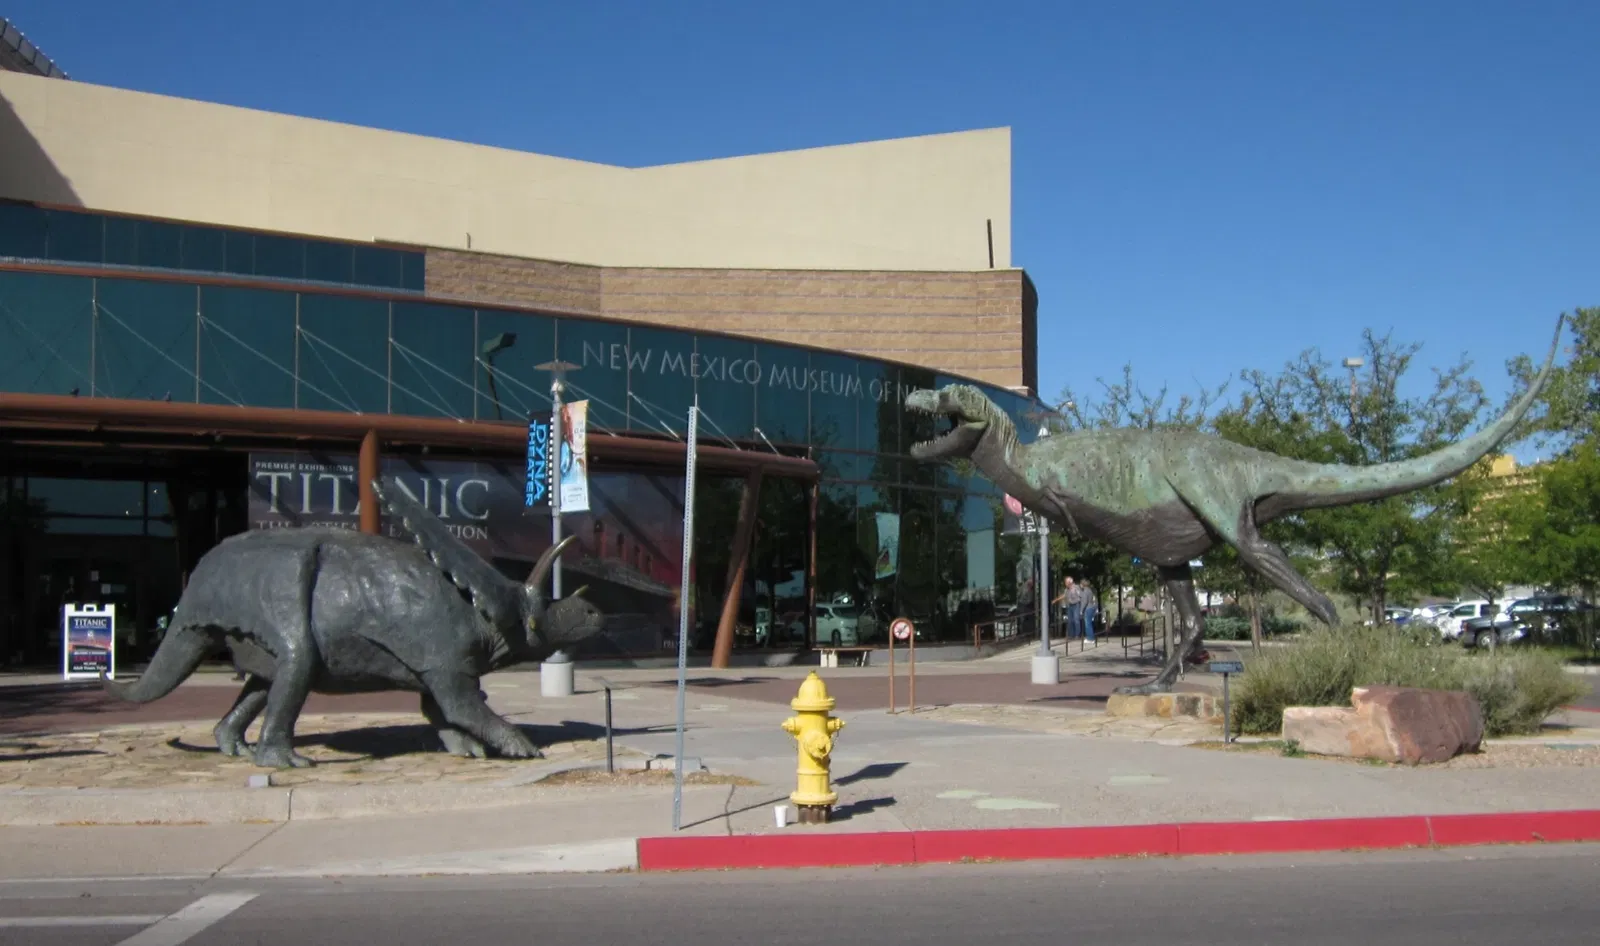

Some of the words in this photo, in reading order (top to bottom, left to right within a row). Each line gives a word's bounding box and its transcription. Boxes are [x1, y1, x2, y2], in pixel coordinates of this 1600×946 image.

[582, 340, 652, 373] NEW
[659, 349, 762, 386] MEXICO
[768, 363, 865, 399] MUSEUM
[869, 378, 893, 403] OF
[255, 461, 296, 470] PREMIER
[525, 419, 537, 507] THEATER
[534, 424, 546, 500] DYNA
[255, 472, 489, 520] TITNIC
[74, 618, 107, 626] TITANIC
